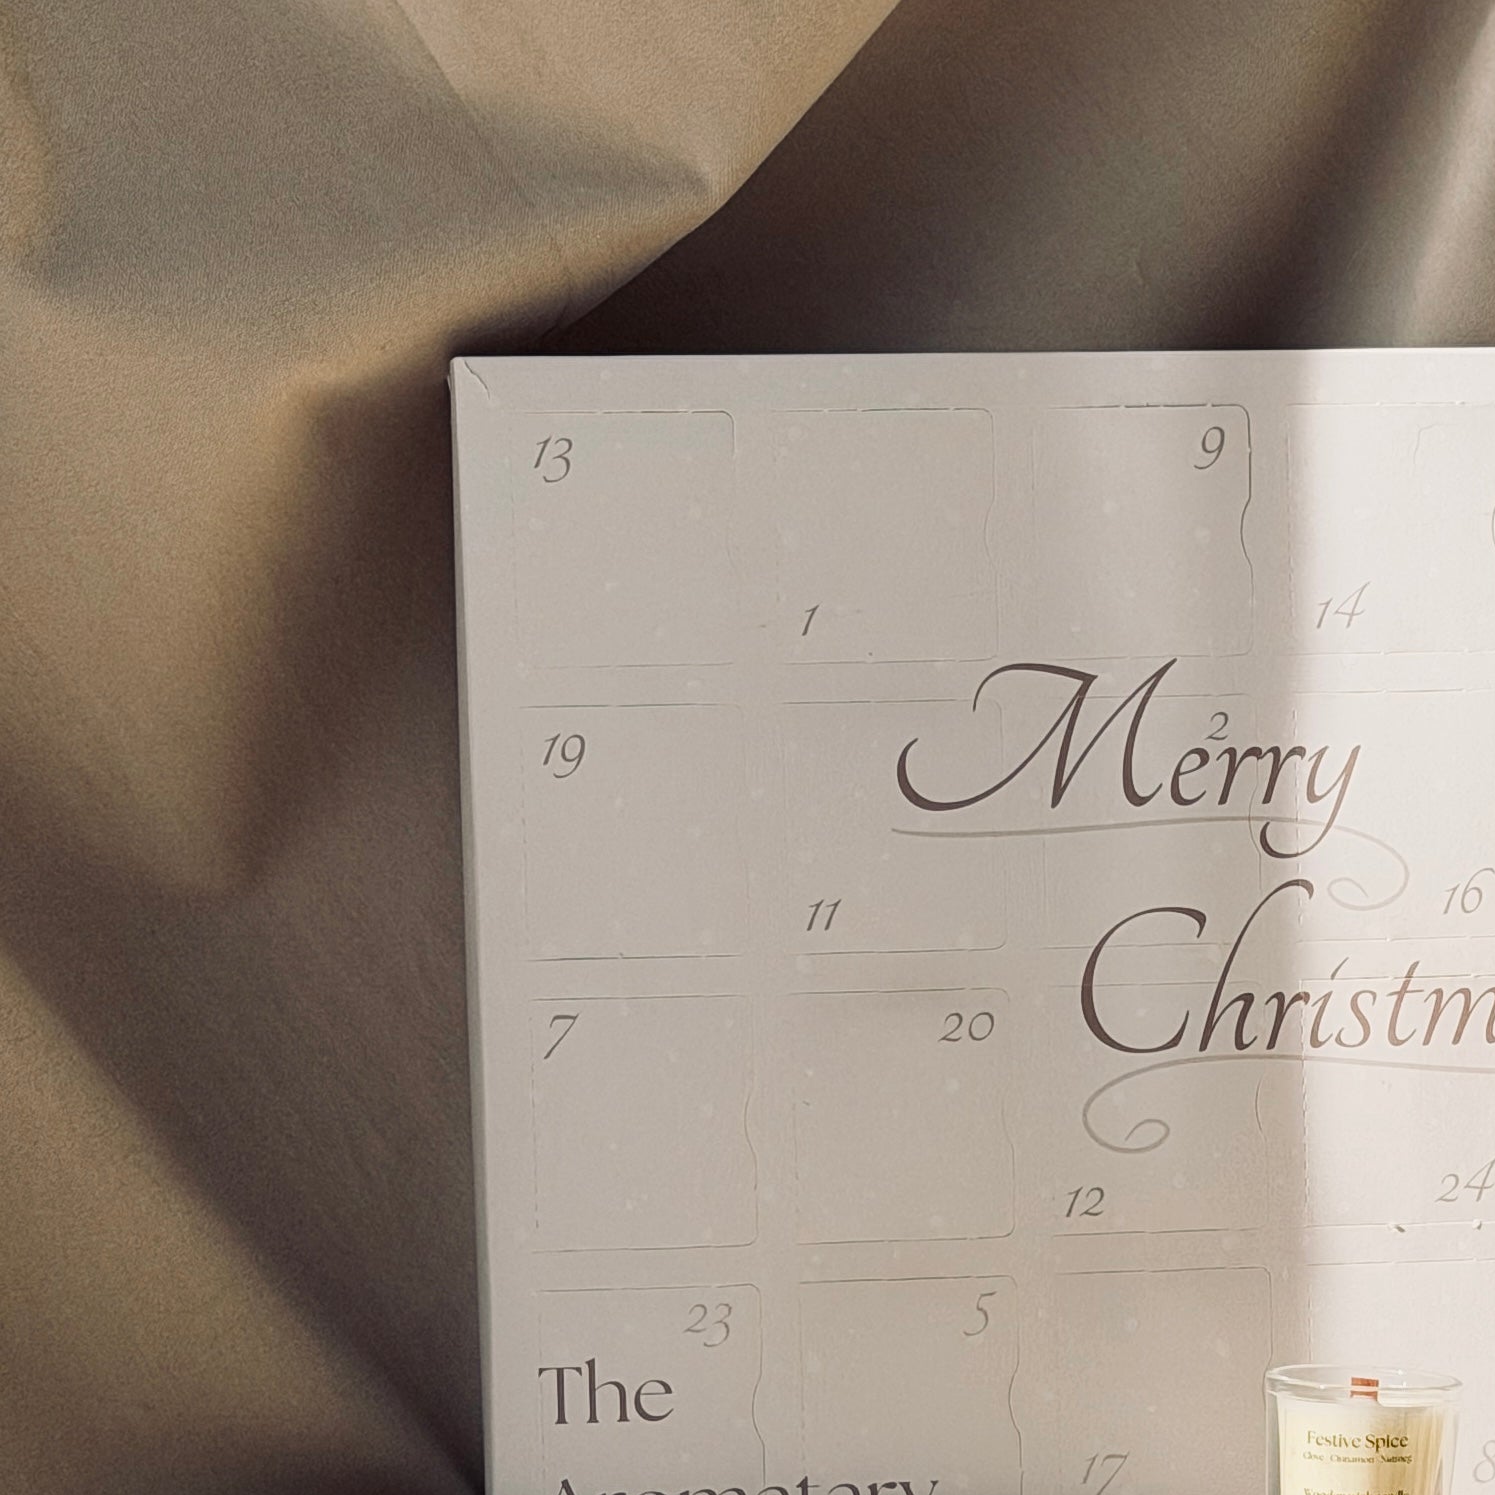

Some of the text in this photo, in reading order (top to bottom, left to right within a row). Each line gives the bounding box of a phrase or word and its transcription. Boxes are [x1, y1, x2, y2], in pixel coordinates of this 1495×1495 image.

[533, 435, 573, 482] 13
[1193, 426, 1225, 470] 9
[801, 604, 820, 637] 1
[1315, 581, 1370, 628] 14
[1207, 712, 1228, 742] 2
[541, 733, 586, 779] 19
[896, 658, 1360, 858] Merry
[1441, 867, 1495, 915] 16
[805, 899, 842, 931] 11
[542, 1014, 579, 1061] 7
[938, 1011, 995, 1042] 20
[1064, 1186, 1105, 1218] 12
[684, 1303, 732, 1348] 23
[963, 1291, 997, 1336] 5
[538, 1358, 674, 1426] The
[1307, 1430, 1408, 1453] Festive Spice
